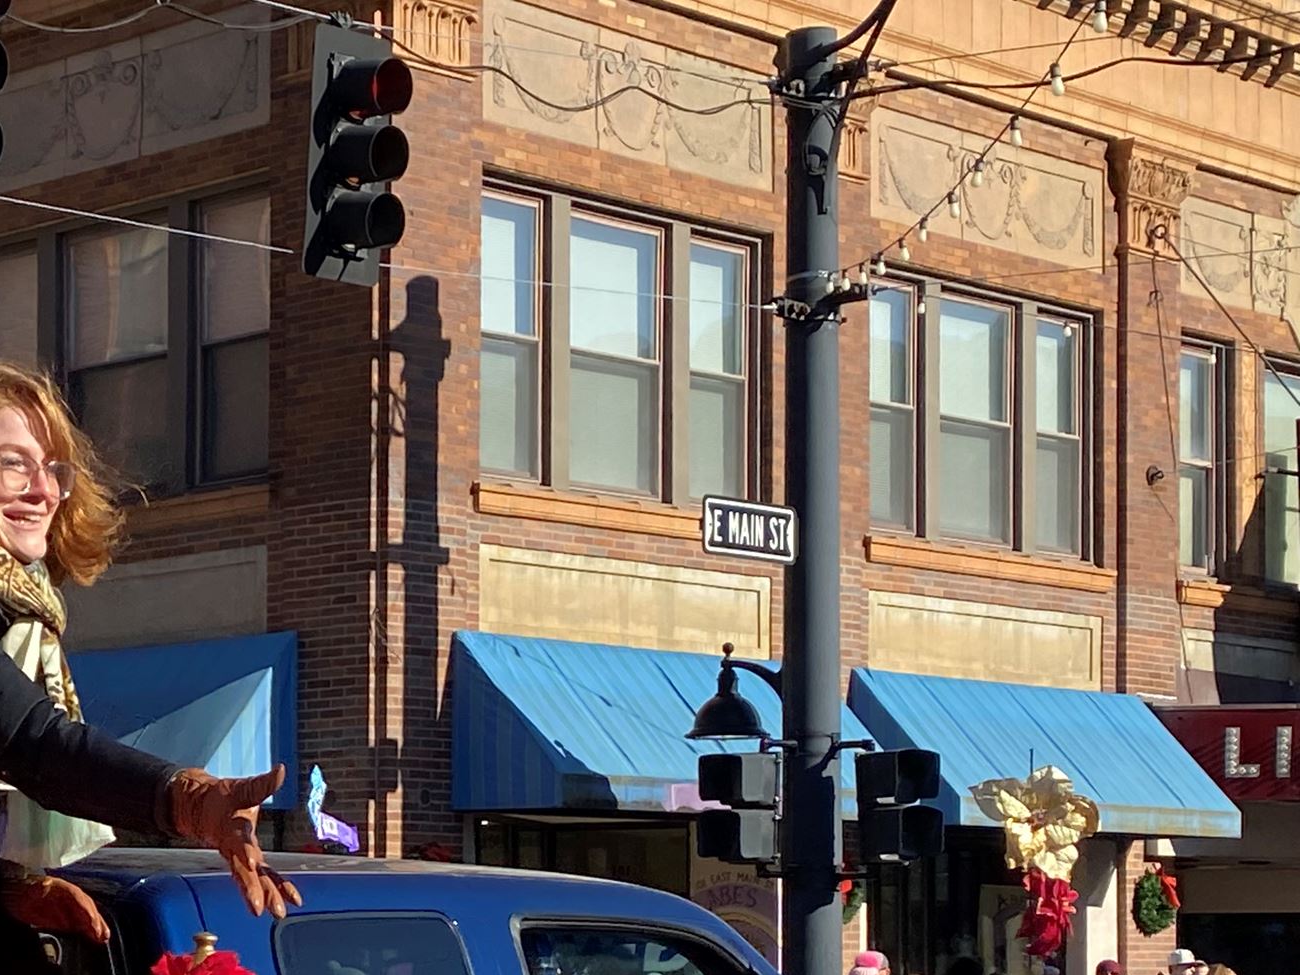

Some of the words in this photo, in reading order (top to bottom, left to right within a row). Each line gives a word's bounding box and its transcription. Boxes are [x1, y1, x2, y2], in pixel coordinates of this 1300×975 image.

[713, 508, 723, 542] E
[728, 511, 764, 548] MAIN
[769, 516, 787, 550] ST
[710, 871, 732, 883] EAST
